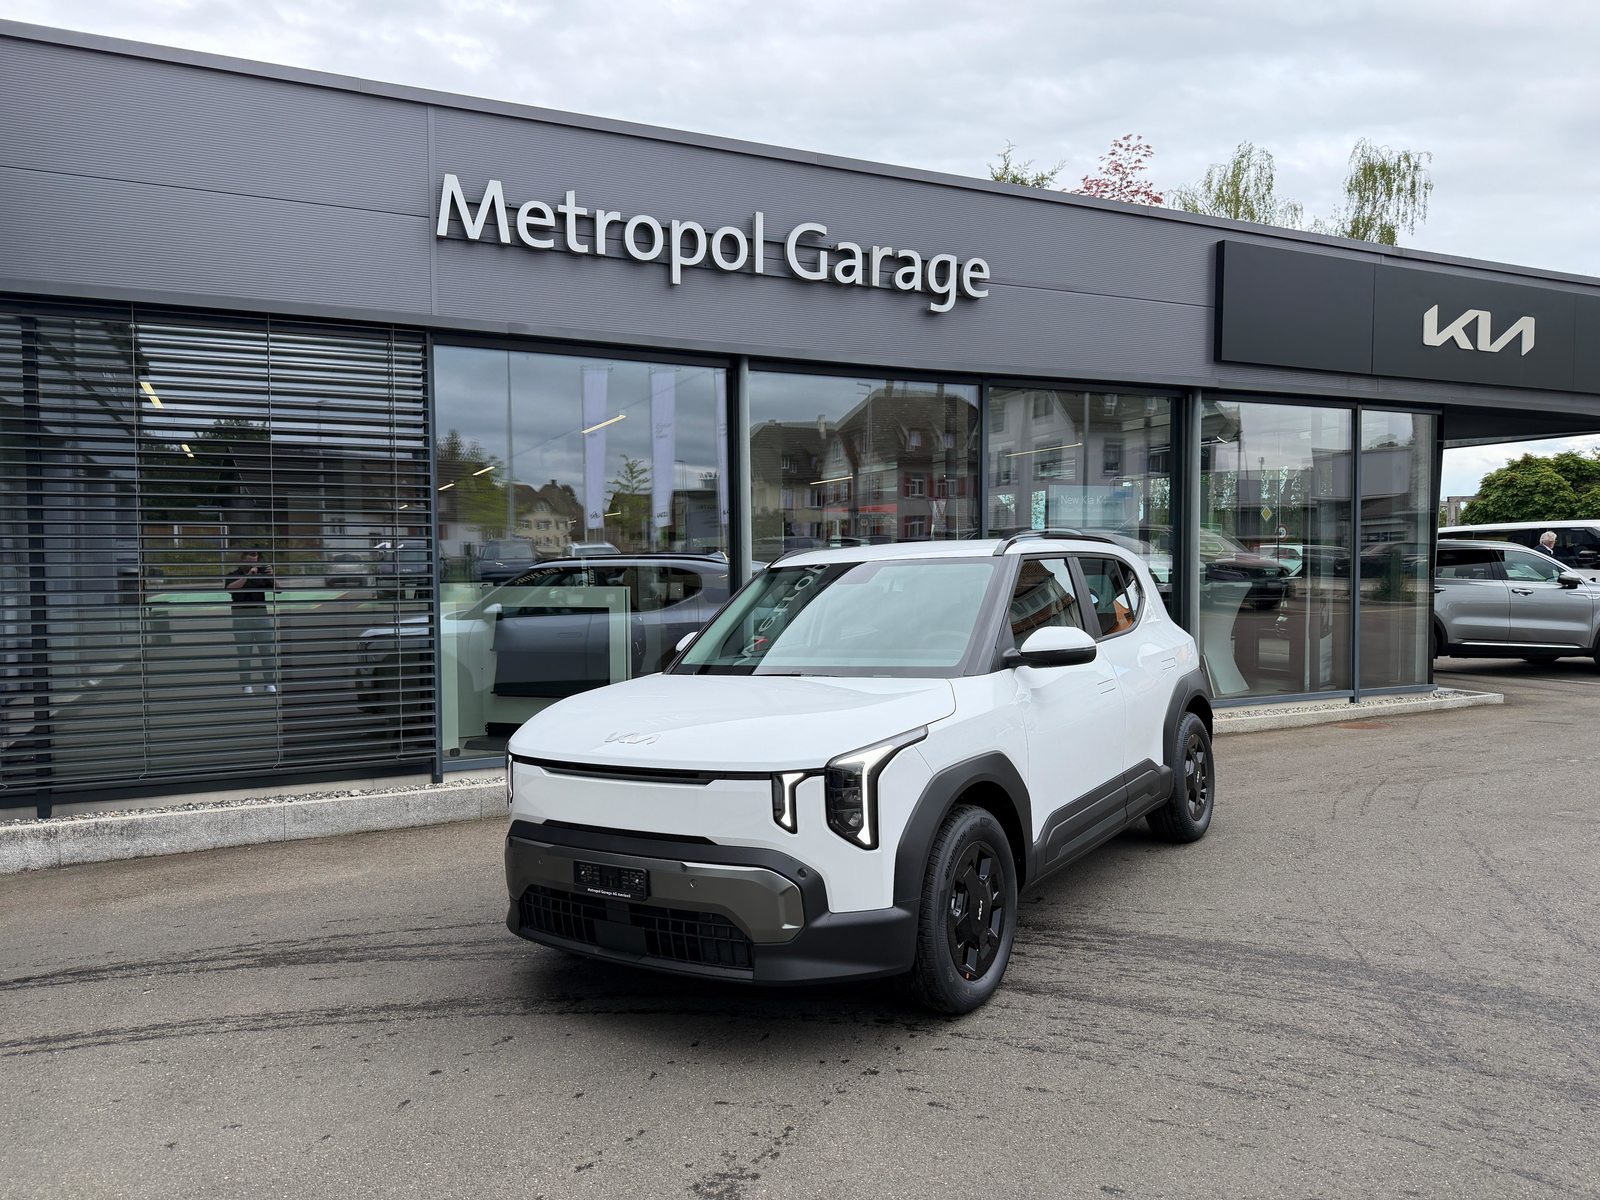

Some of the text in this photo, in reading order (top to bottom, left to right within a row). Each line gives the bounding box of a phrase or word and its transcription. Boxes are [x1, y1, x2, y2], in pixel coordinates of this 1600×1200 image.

[437, 173, 992, 313] Metropol Garage
[1422, 303, 1536, 357] KIA
[1060, 495, 1080, 505] New
